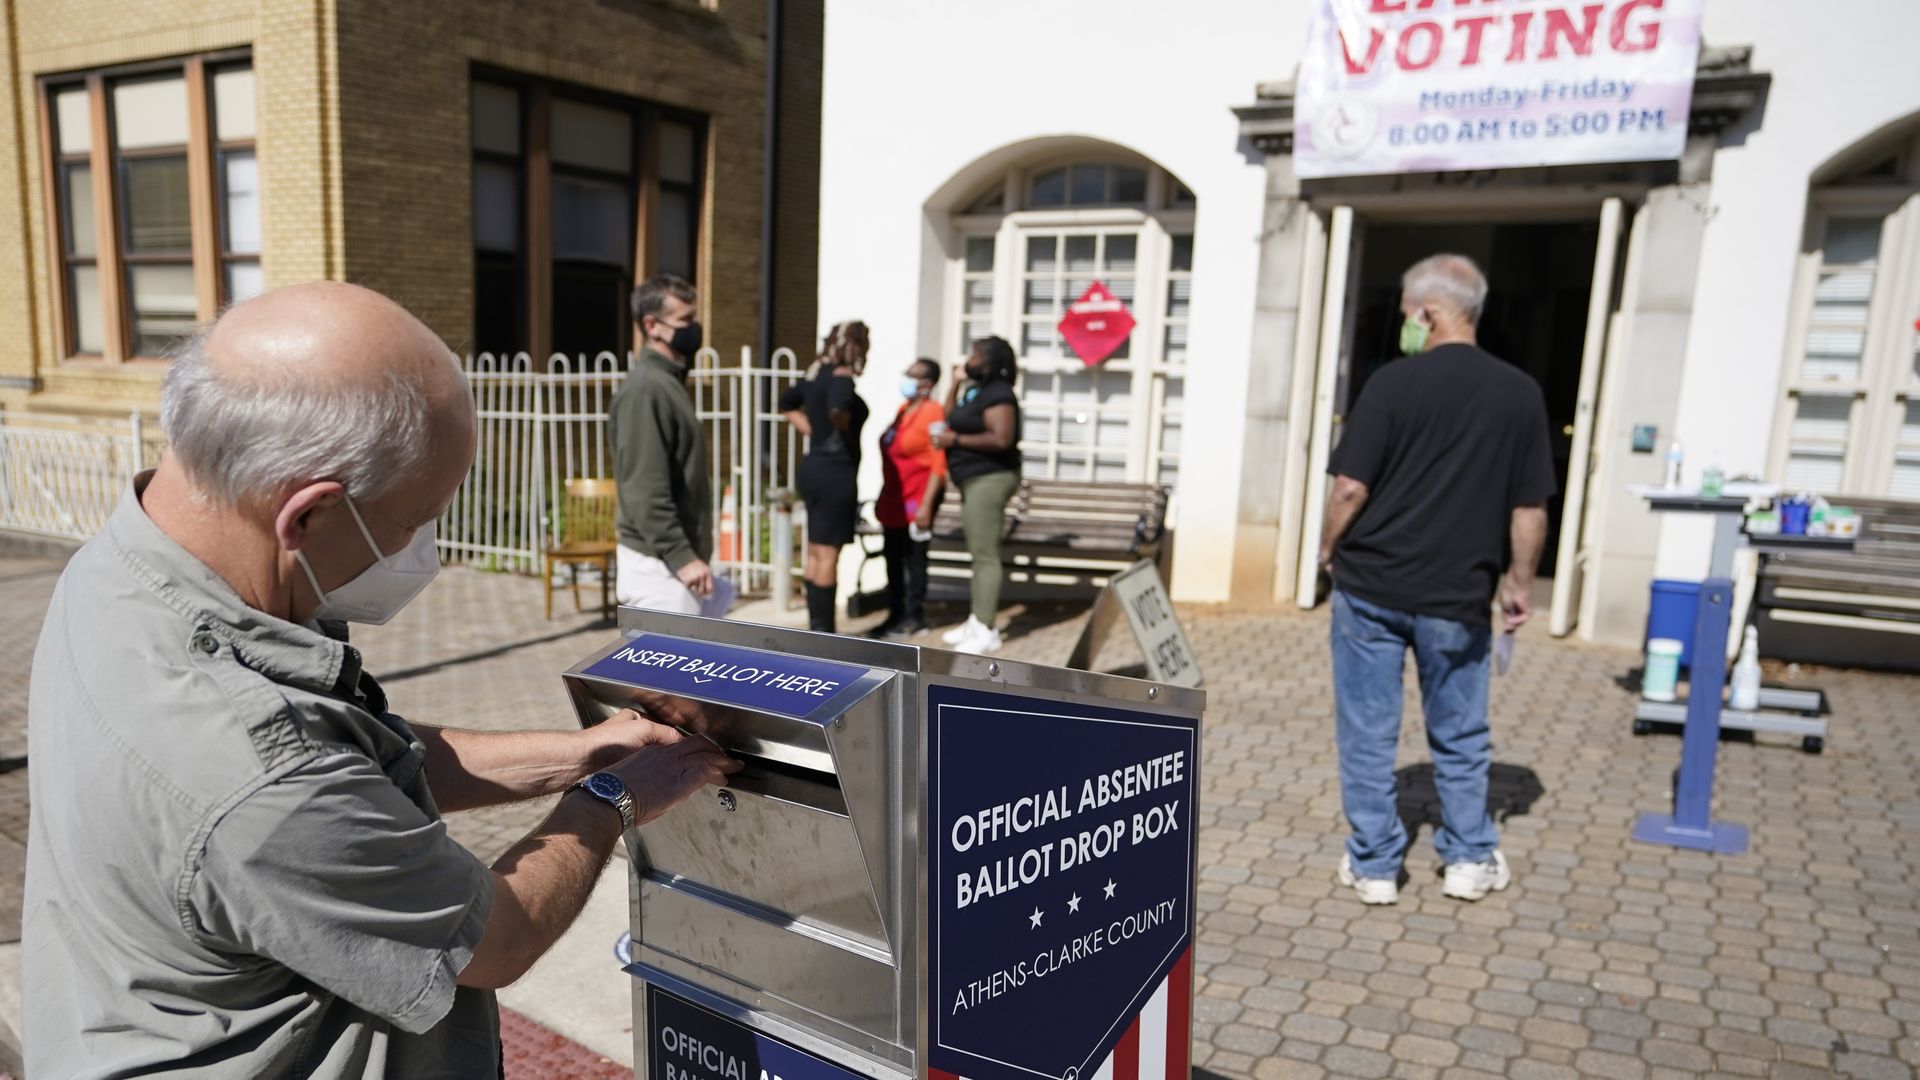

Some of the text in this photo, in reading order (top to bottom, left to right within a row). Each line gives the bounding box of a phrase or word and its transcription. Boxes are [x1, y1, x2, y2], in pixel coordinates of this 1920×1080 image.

[1338, 0, 1664, 75] VOTING
[1419, 79, 1637, 111] Monday-Friday
[1456, 119, 1501, 142] AM
[1509, 117, 1537, 139] to
[1545, 110, 1610, 137] 5:00
[1617, 107, 1668, 132] PM
[1132, 585, 1169, 632] VOTE
[612, 647, 839, 697] INSERT BALLOT HERE
[1153, 633, 1190, 682] HERE
[951, 750, 1185, 853] OFFICIAL ABSENTEE
[957, 800, 1180, 910] BALLOT DROP BOX
[952, 898, 1176, 1016] ATHENS-CLARKE COUNTY
